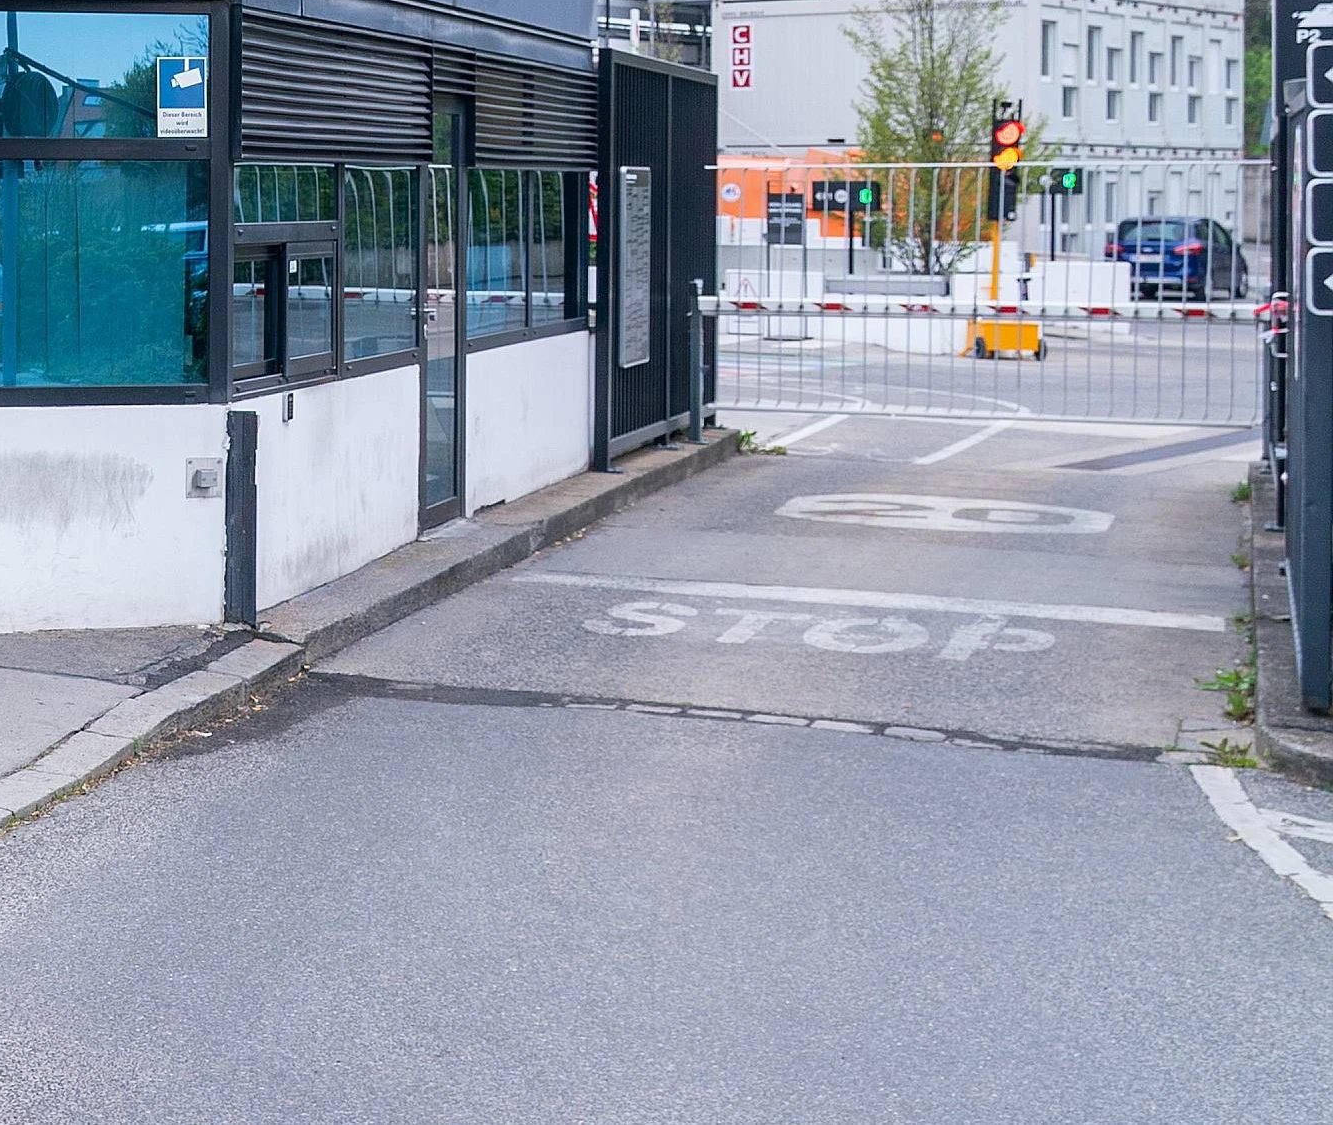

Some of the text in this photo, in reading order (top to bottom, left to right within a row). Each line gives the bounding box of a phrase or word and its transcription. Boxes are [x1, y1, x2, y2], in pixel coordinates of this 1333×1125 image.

[733, 25, 751, 87] CHV
[1295, 28, 1322, 44] P2
[794, 497, 1083, 527] 20
[581, 601, 1056, 662] STOP
